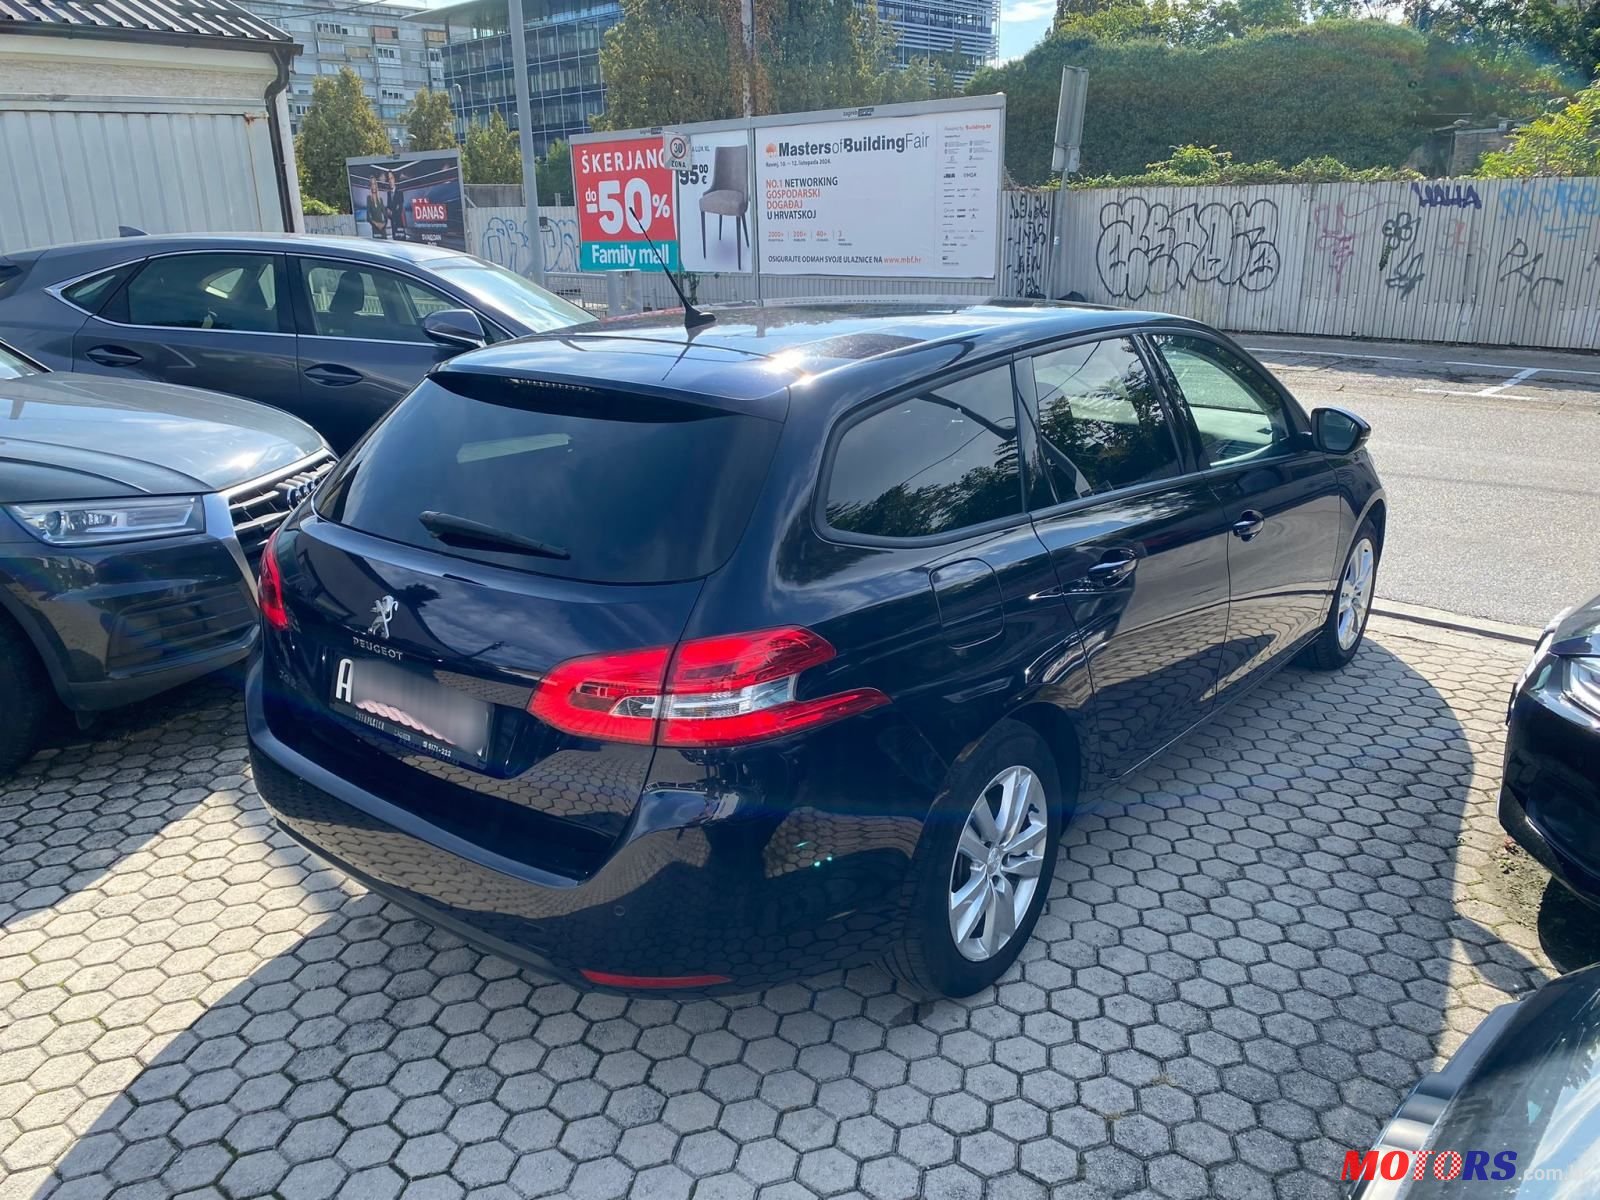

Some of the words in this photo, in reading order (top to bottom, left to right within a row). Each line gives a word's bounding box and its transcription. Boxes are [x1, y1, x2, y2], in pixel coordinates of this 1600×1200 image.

[674, 143, 683, 153] 30
[702, 175, 707, 185] €
[766, 179, 783, 189] NO.1
[785, 176, 838, 189] NETWORKING
[585, 187, 597, 202] do
[766, 188, 821, 200] GOSPODARSKI
[766, 199, 803, 210] DOGAĐAJ
[415, 206, 445, 220] DANAS
[767, 211, 773, 220] U
[774, 209, 817, 220] HRVATSKOJ
[592, 244, 636, 267] Family
[639, 244, 670, 264] mall
[768, 255, 802, 264] OSIGURAJTE
[802, 254, 825, 264] ODMAH
[824, 255, 842, 264] SVOJE
[843, 255, 873, 264] ULAZNICE
[873, 255, 883, 264] NA
[884, 255, 922, 265] www.mbf.hr
[352, 636, 403, 661] PEUGEOT
